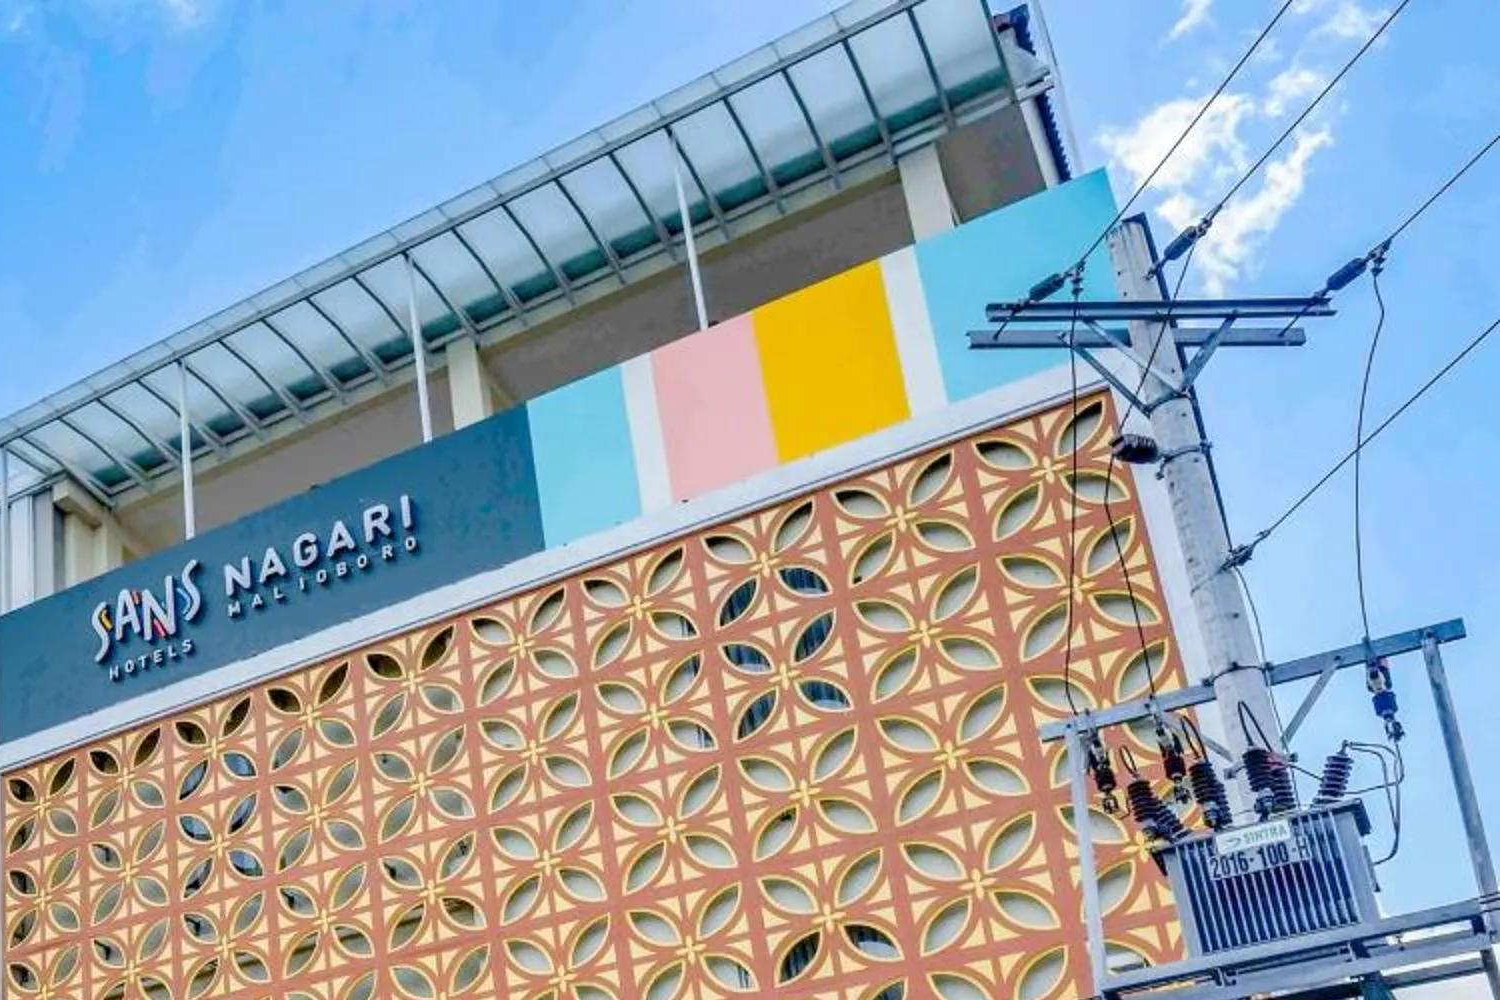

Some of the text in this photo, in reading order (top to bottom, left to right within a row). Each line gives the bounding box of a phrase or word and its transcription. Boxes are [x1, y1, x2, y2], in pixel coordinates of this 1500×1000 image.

[224, 494, 412, 596] NAGARI
[228, 536, 417, 617] MALIOBORO
[91, 559, 200, 664] SANS
[109, 639, 194, 681] HOTELS
